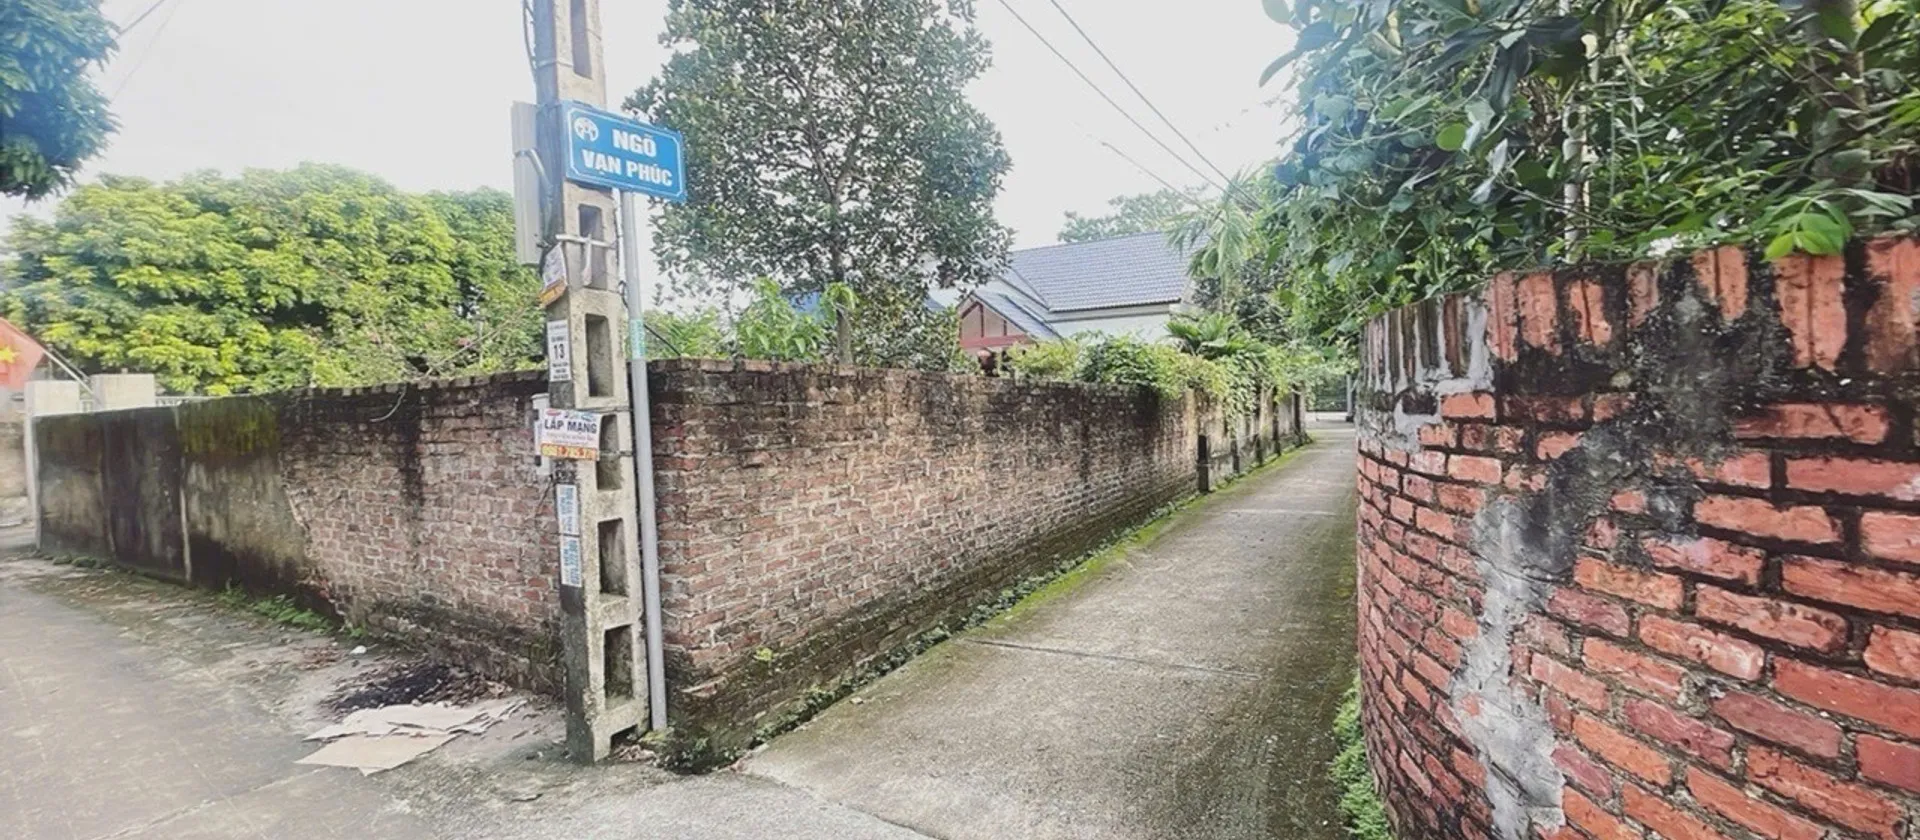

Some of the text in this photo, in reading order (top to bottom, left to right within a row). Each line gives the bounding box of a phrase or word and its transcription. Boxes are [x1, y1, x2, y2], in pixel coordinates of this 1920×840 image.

[582, 148, 673, 187] VẠN PHÚC
[553, 343, 565, 360] 13
